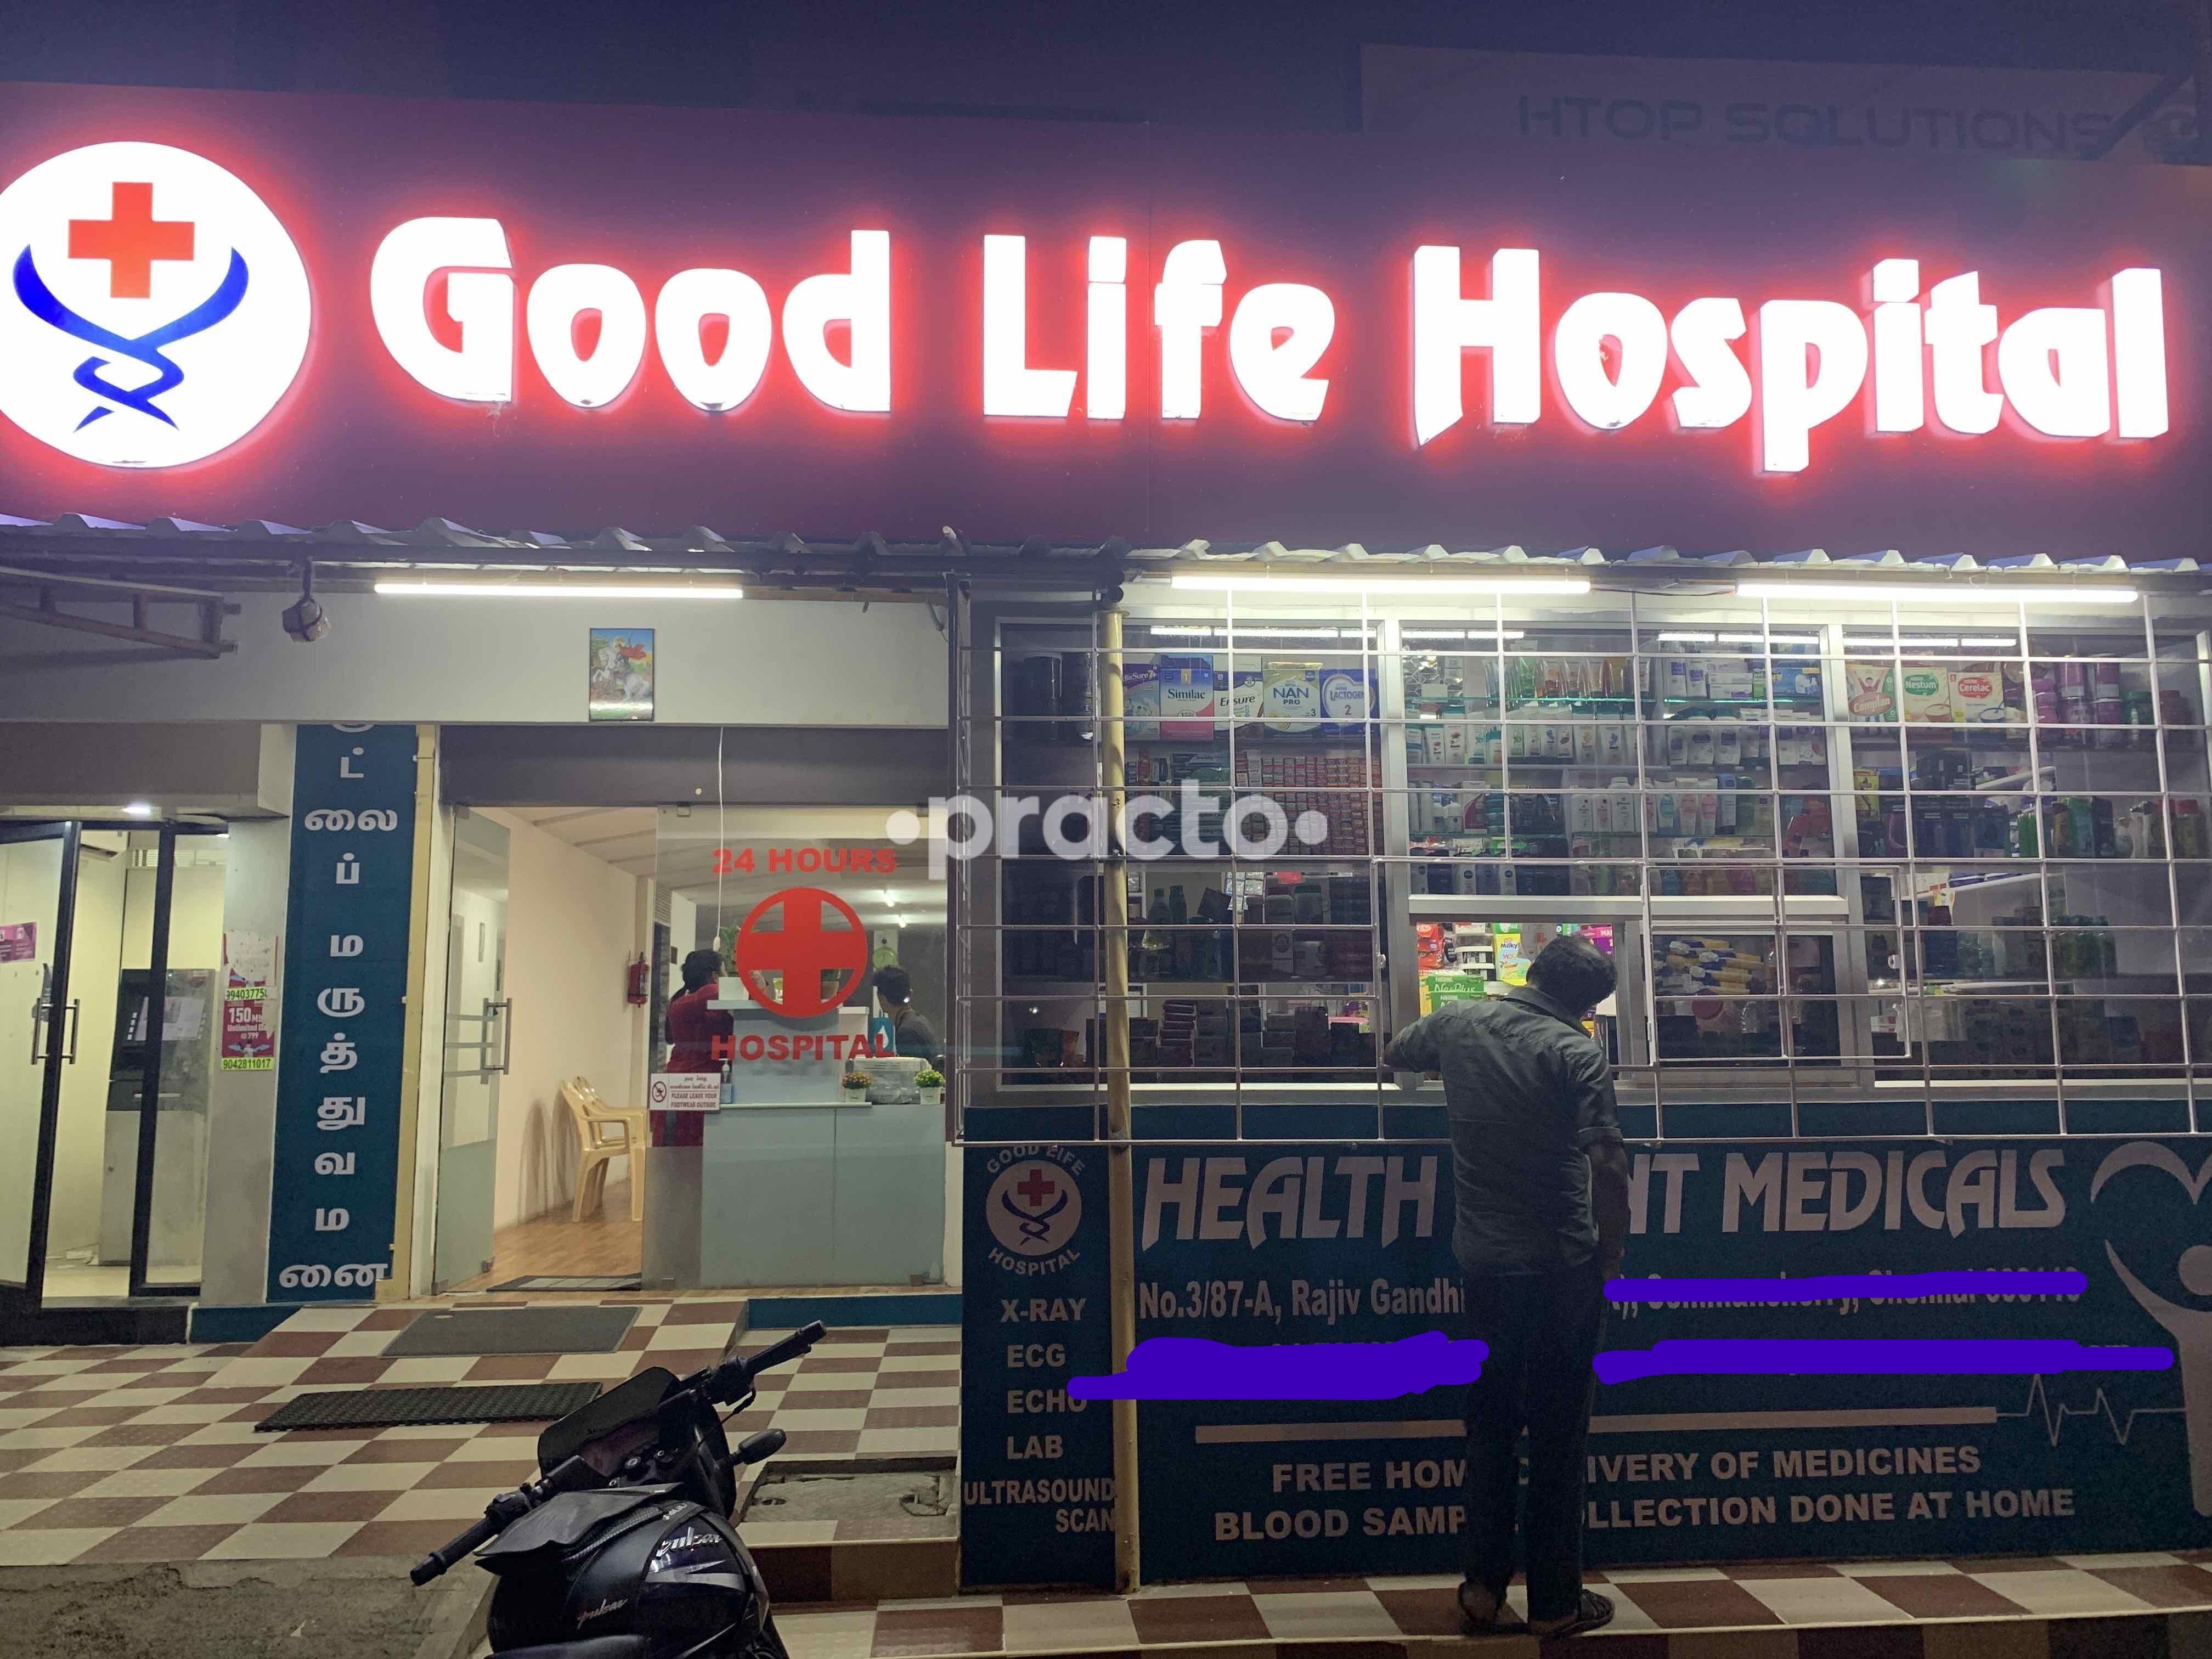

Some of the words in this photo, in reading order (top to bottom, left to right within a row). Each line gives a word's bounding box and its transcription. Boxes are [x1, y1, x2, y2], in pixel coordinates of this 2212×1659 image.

[371, 217, 892, 413] Good
[983, 234, 1335, 422] Life
[1413, 245, 2169, 474] Hospital
[1167, 689, 1205, 699] Similac
[1273, 687, 1309, 698] NAN
[1905, 680, 1937, 690] Nestum
[1959, 682, 1990, 693] Cerelac
[1310, 708, 1316, 717] 3
[1345, 705, 1351, 715] 2
[1853, 695, 1891, 713] Complan
[713, 848, 754, 873] 24
[769, 848, 896, 873] HOURS
[710, 1034, 895, 1060] HOSPITAL
[223, 1059, 271, 1069] 9042811017
[987, 1146, 1039, 1174] GOOD
[1142, 1156, 1438, 1251] HEALTH
[1722, 1149, 2066, 1239] MEDICALS
[988, 1247, 1080, 1276] HOSPITAL
[1001, 1298, 1086, 1323] X-RAY
[1139, 1280, 1282, 1324] No.3/87-A,
[1291, 1279, 1361, 1325] Rajiv
[1007, 1344, 1066, 1368] ECG
[1007, 1435, 1064, 1460] LAB
[1272, 1462, 1372, 1493] FREE
[1710, 1451, 1759, 1480] OF
[1773, 1446, 1981, 1478] MEDICINES
[963, 1477, 1115, 1505] ULTRASOUND
[1055, 1508, 1116, 1533] SCAN
[1215, 1509, 1349, 1541] BLOOD
[1791, 1493, 1895, 1523] DONE
[1907, 1491, 1953, 1520] AT
[1966, 1488, 2075, 1519] HOME
